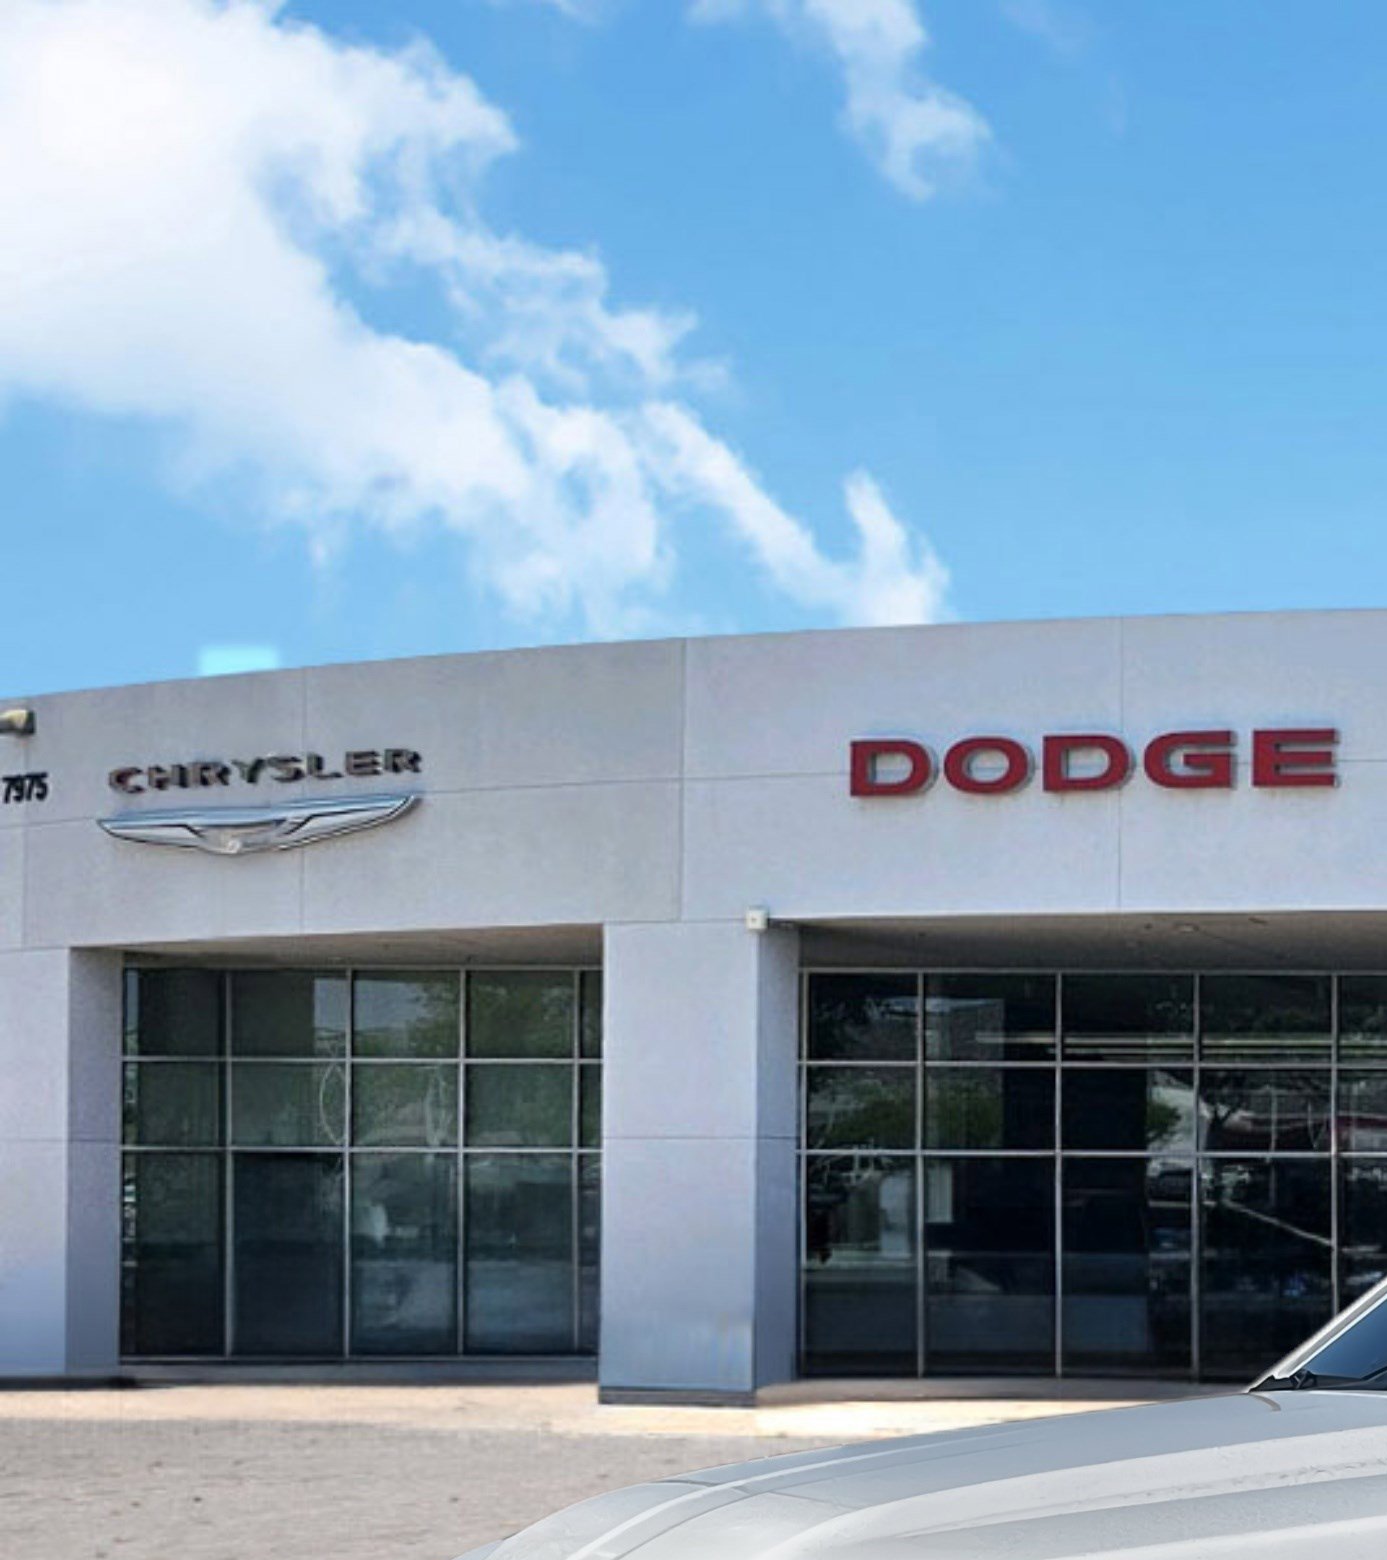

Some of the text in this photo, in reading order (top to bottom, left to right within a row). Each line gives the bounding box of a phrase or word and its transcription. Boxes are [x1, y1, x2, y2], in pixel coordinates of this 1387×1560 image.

[108, 748, 423, 795] CHRYSLER
[850, 728, 1341, 797] DODGE
[2, 772, 49, 804] 7975
